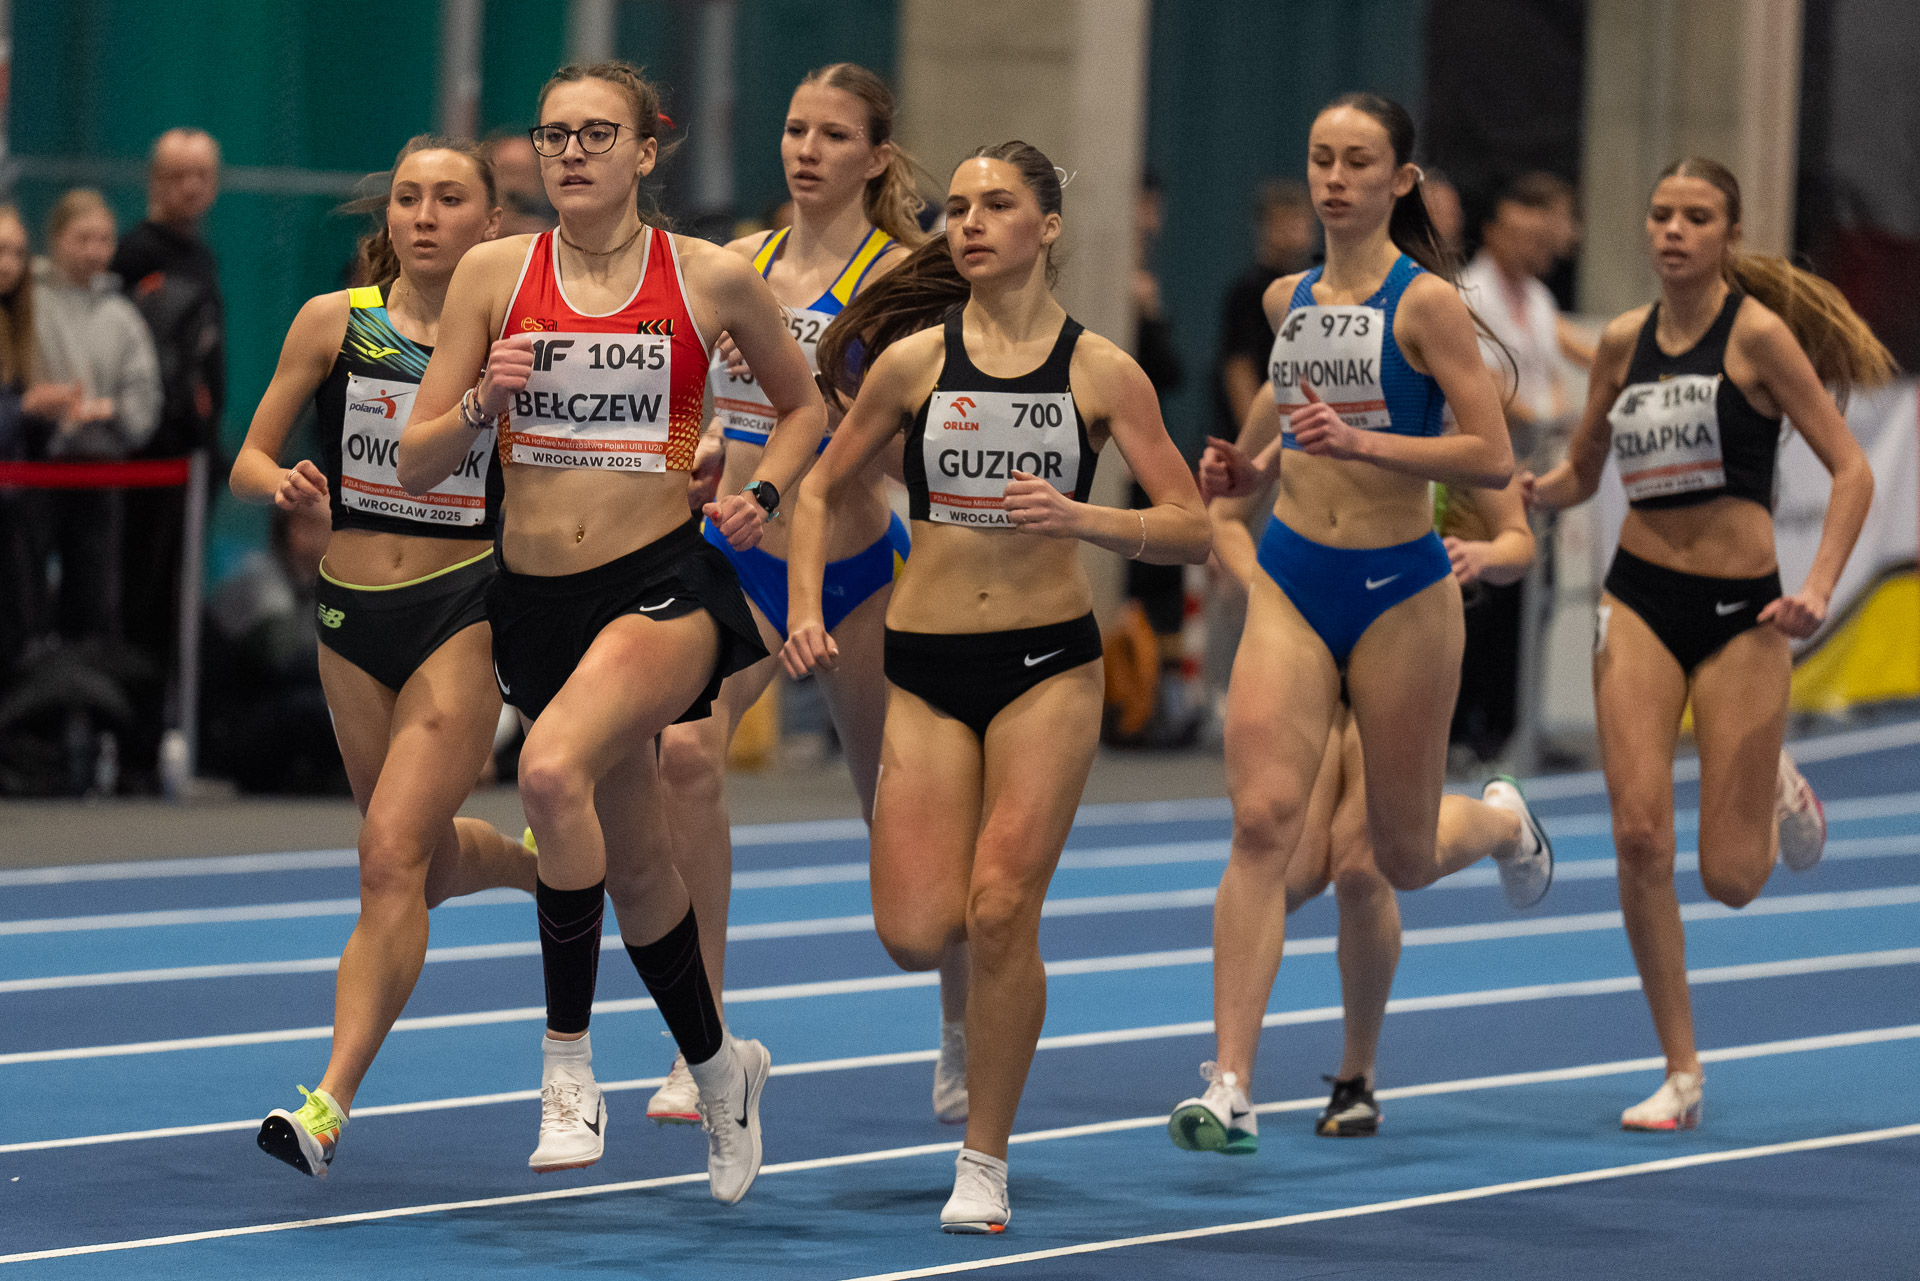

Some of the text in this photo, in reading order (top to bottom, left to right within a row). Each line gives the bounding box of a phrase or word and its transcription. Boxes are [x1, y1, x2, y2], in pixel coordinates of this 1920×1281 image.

[1321, 314, 1370, 337] 973
[588, 343, 665, 370] 1045
[1272, 358, 1375, 387] REJMONIAK
[349, 402, 385, 416] polanik
[515, 390, 663, 423] BEŁCZEW
[1011, 402, 1063, 429] 700
[943, 421, 979, 431] ORLEN
[515, 434, 531, 445] PZLA
[532, 437, 557, 448] Halowe
[557, 440, 603, 450] Mistrzostwa
[604, 442, 628, 451] Polski
[629, 443, 643, 451] U18
[648, 444, 664, 452] U20
[532, 452, 642, 468] WROCŁAW 2025
[938, 449, 1063, 479] GUZIOR
[344, 480, 359, 491] PZLA
[359, 483, 385, 494] Halowe
[429, 495, 450, 504] Polski
[358, 497, 461, 522] WROCŁAW 2025
